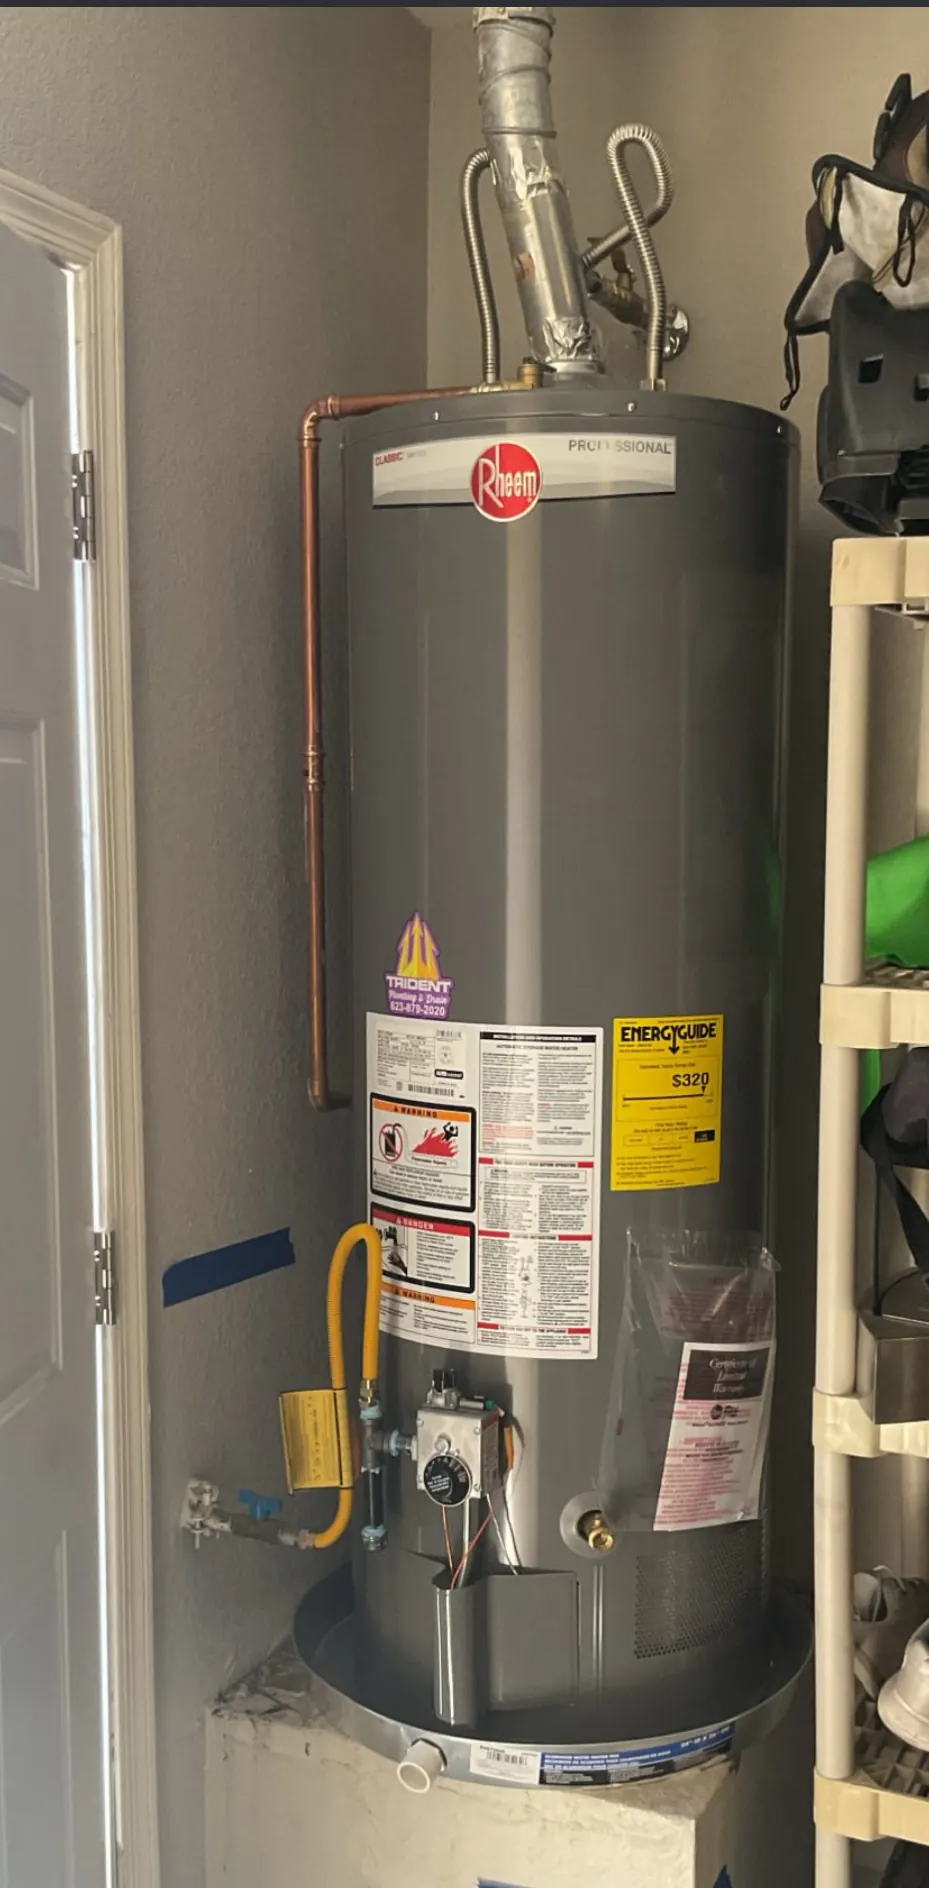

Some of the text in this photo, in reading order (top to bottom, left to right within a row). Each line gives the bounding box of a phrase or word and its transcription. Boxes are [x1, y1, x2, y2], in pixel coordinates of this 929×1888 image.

[478, 443, 537, 508] Rheem
[385, 975, 452, 993] TRIDENT
[621, 1022, 717, 1043] ENERGYGUIDE
[672, 1072, 709, 1088] $320
[401, 1107, 438, 1119] WARNING
[403, 1218, 434, 1230] DANGER
